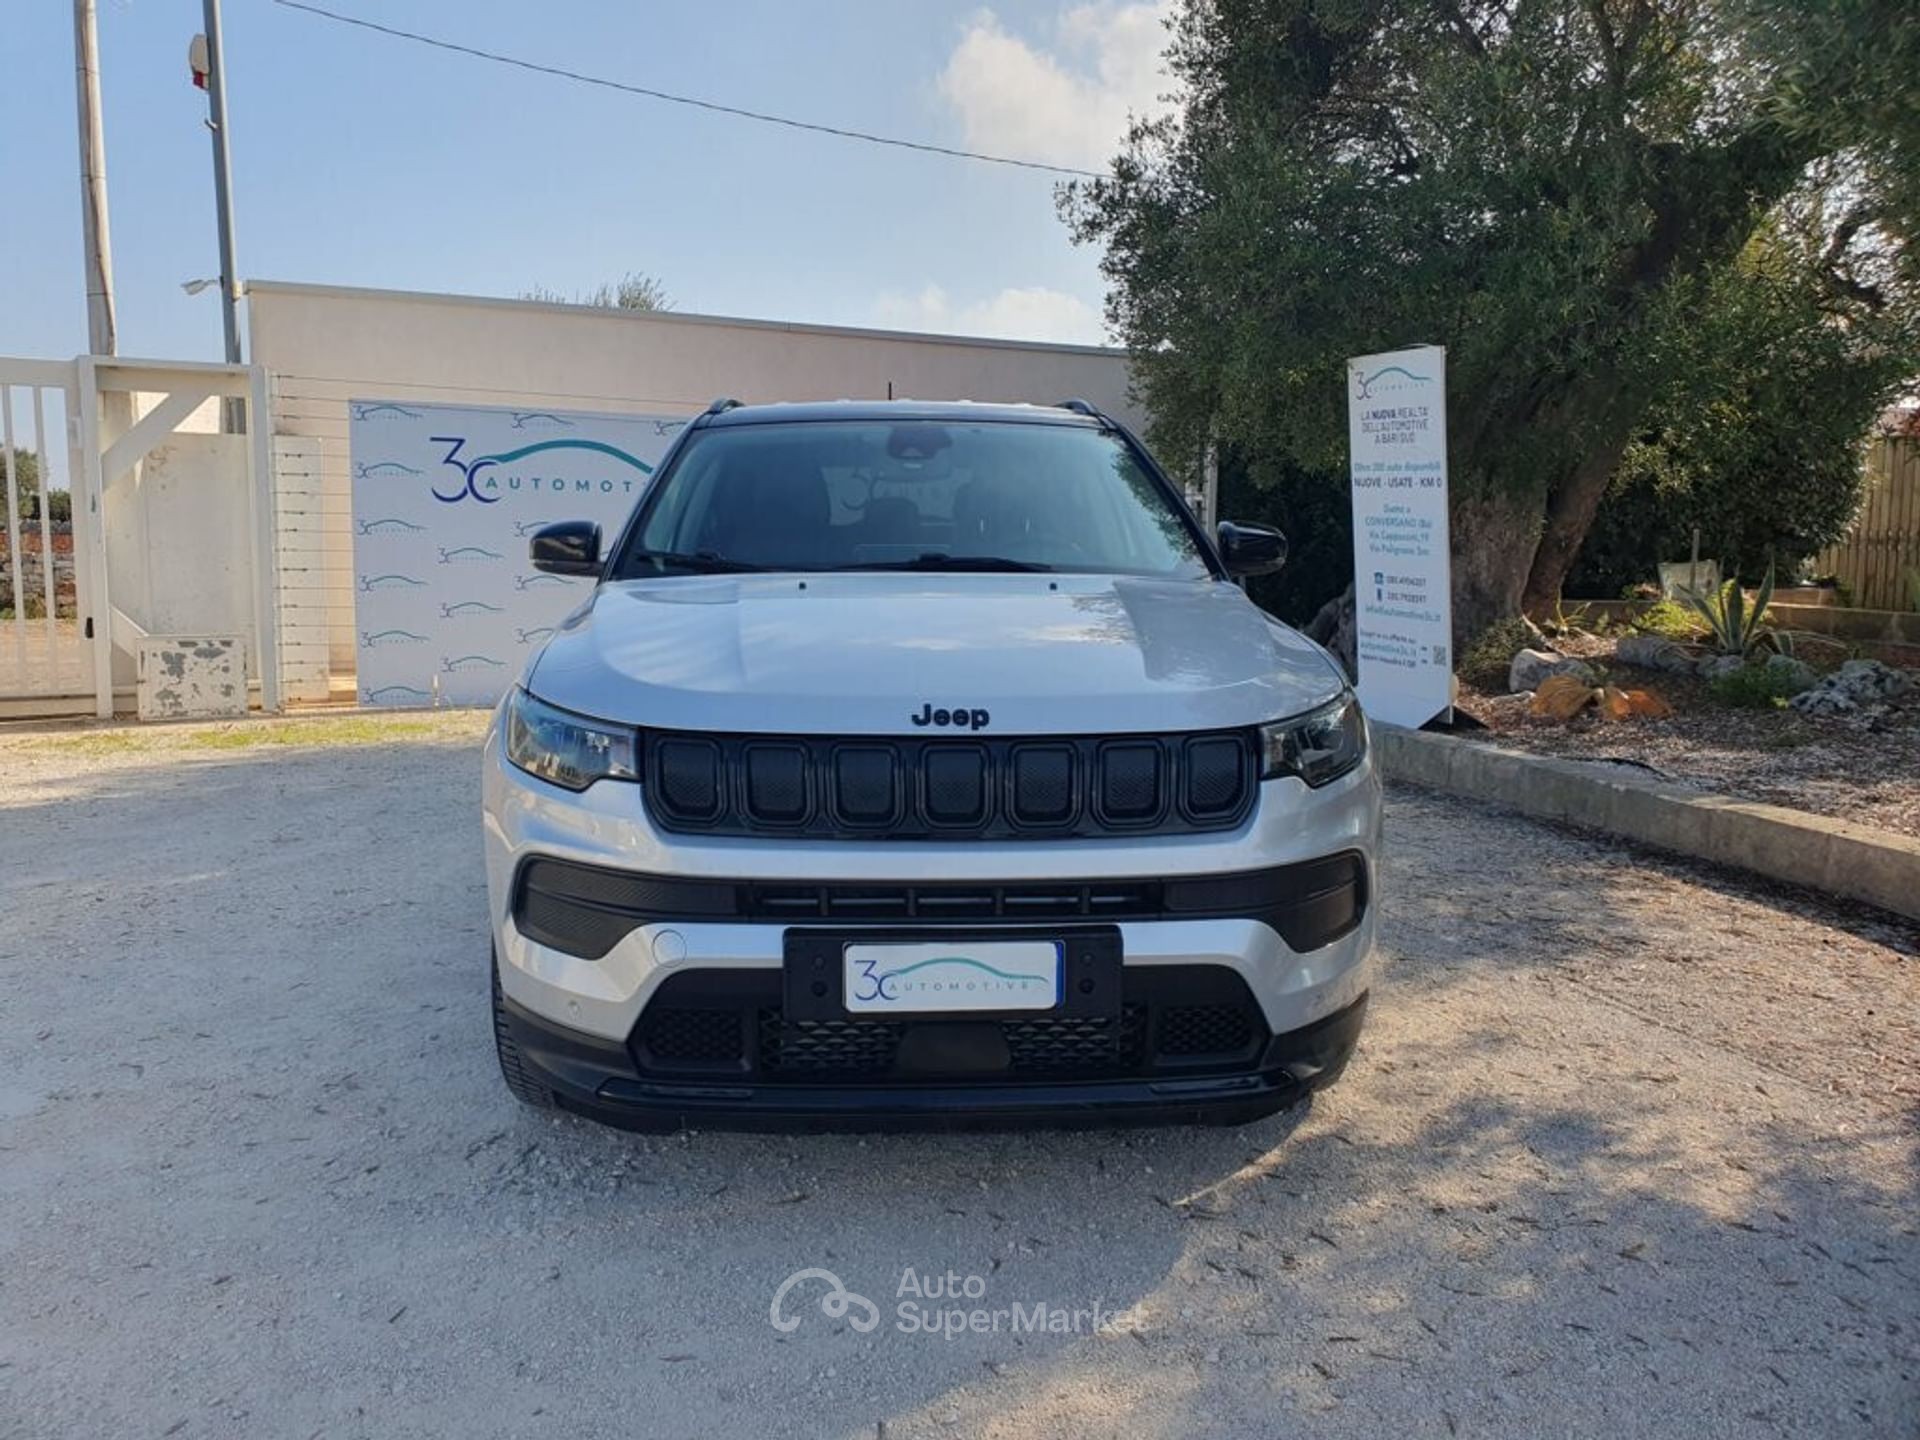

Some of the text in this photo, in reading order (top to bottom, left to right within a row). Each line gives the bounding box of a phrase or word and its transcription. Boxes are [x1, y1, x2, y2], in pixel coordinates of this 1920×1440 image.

[485, 476, 647, 492] AUTOMOT
[1354, 477, 1381, 488] NUOVE
[1388, 476, 1413, 488] USATE
[911, 703, 990, 731] Jeep
[889, 981, 1029, 992] AUTOMOTIVE
